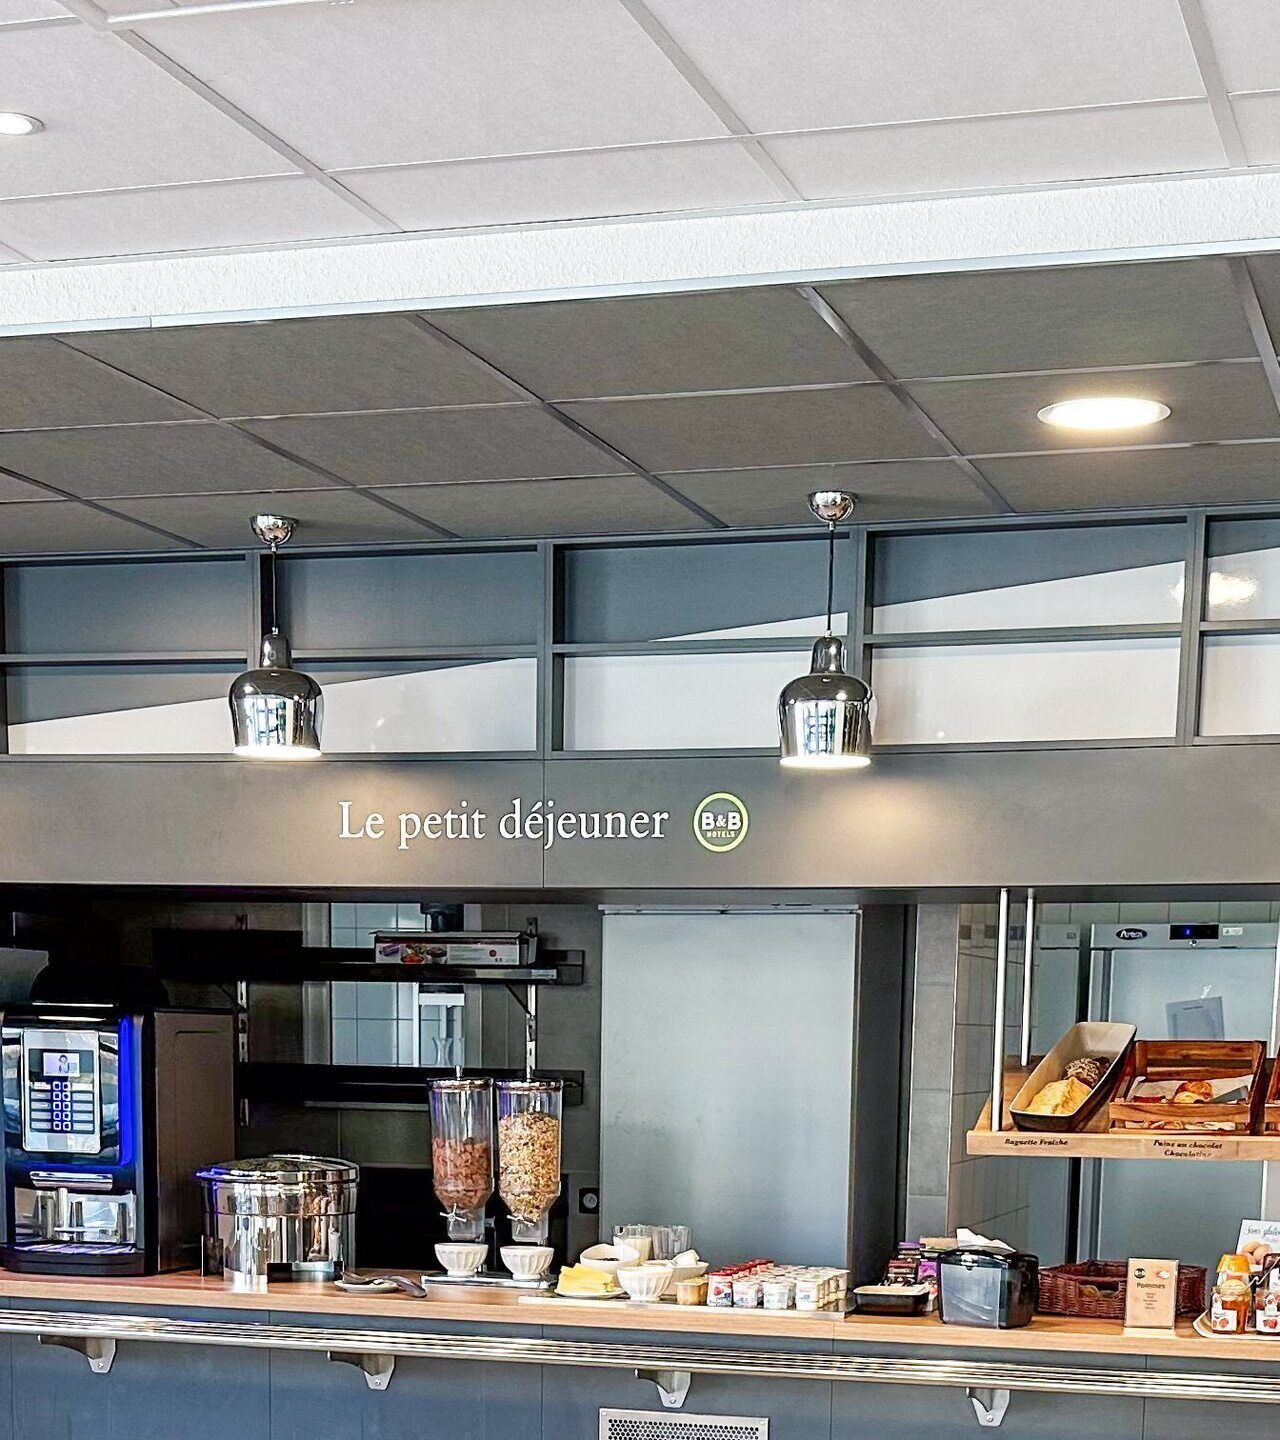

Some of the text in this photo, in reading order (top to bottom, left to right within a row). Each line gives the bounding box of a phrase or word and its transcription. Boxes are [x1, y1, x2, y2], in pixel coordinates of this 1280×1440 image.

[338, 797, 669, 850] Le petit déjeuner
[701, 811, 742, 830] B&B
